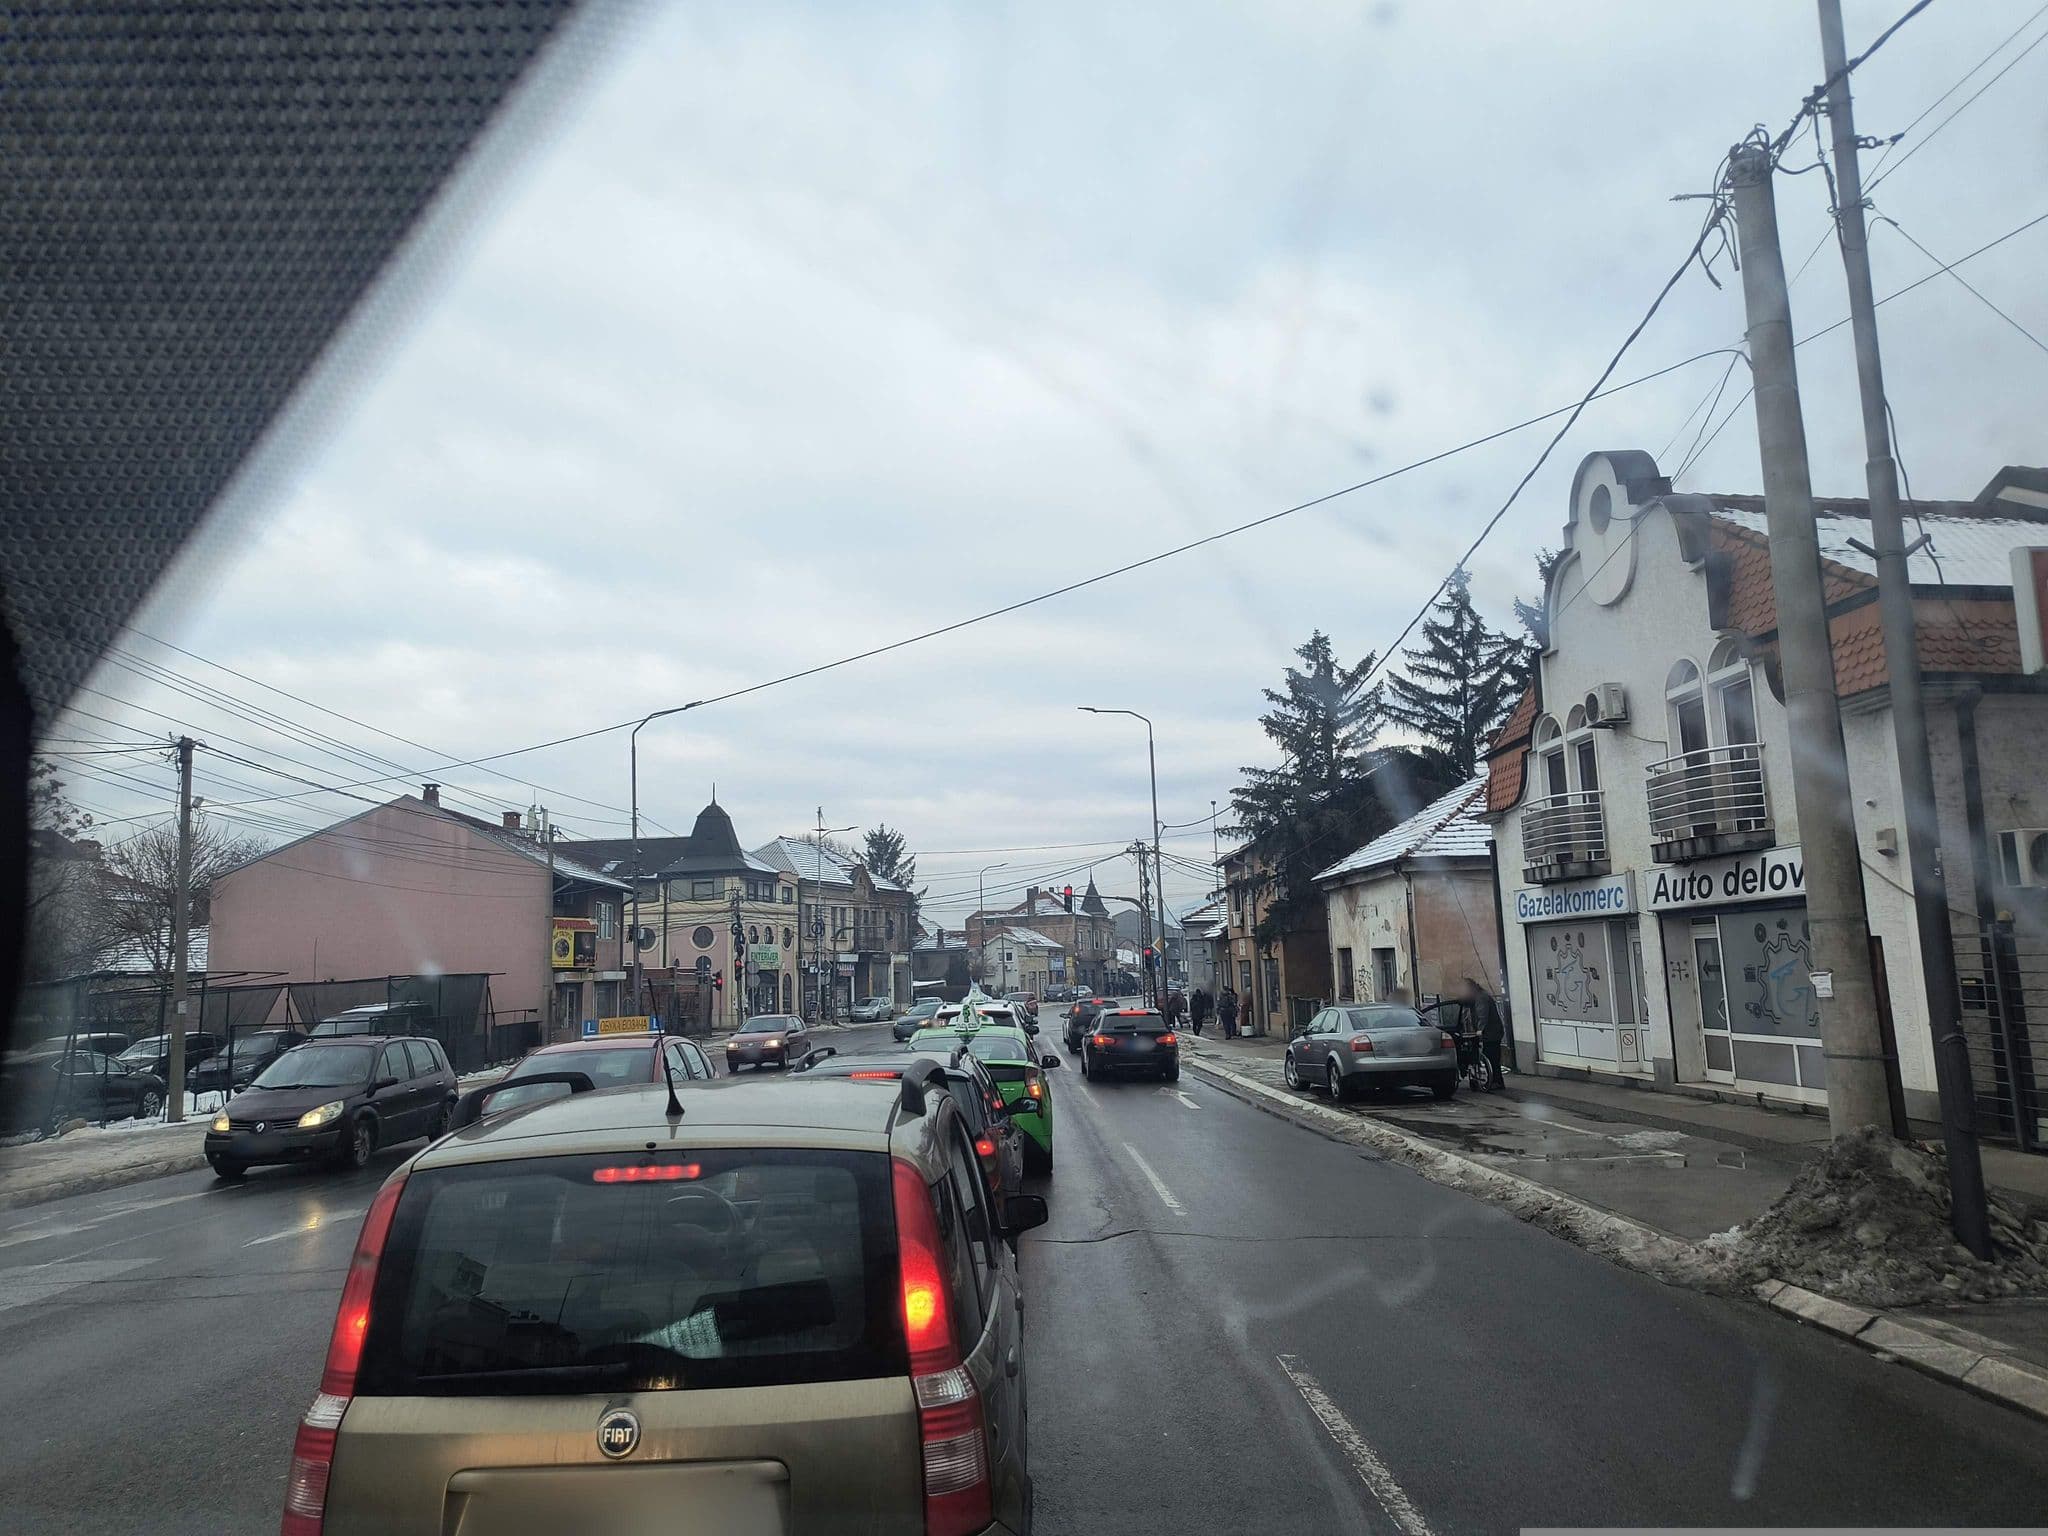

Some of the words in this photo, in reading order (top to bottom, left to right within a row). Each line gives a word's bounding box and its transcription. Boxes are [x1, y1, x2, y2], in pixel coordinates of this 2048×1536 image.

[1653, 872, 1713, 904] Auto
[1518, 886, 1624, 918] Gazelakomerc
[587, 1022, 596, 1033] L
[604, 1427, 632, 1443] FIAT
